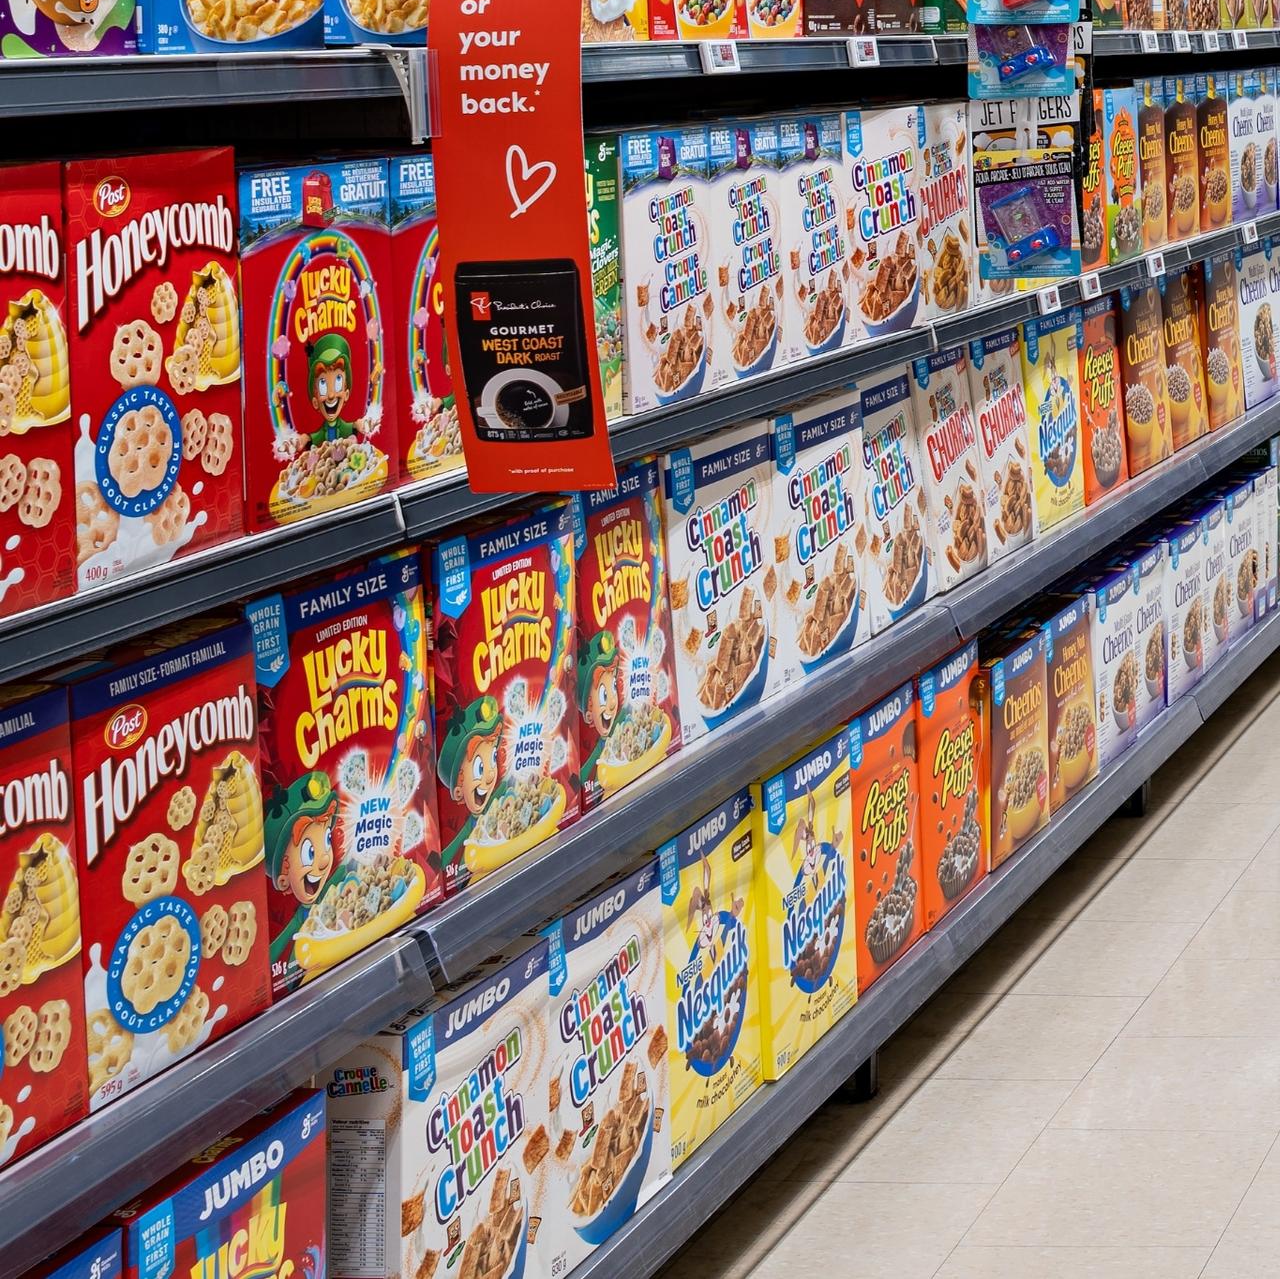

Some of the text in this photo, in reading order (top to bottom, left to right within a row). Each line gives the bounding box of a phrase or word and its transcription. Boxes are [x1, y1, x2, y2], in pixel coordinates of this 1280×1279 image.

[459, 28, 521, 55] your
[460, 61, 550, 86] money
[628, 138, 651, 155] FREE
[680, 144, 708, 160] GRATUIT
[710, 130, 731, 145] FREE
[1113, 130, 1135, 157] Reese's
[100, 181, 126, 206] Post
[251, 176, 292, 198] FREE
[252, 196, 292, 208] INSULATED
[340, 180, 386, 202] GRATUIT
[649, 185, 694, 223] Cinnamon
[76, 195, 233, 332] Honeycomb
[665, 251, 699, 286] Croque
[300, 265, 350, 310] Lucky
[660, 269, 708, 314] Cannelle
[295, 299, 356, 344] Charms
[489, 324, 555, 336] GOURMET
[481, 336, 565, 352] WEST COAST
[496, 351, 561, 365] DARK ROAST
[1091, 376, 1115, 414] Puffs
[1038, 390, 1078, 460] Nesquik
[702, 449, 751, 479] FAMILY SIZE
[686, 477, 757, 552] Cinnamon
[796, 489, 855, 566] Crunch
[480, 521, 548, 558] FAMILY SIZE
[703, 510, 750, 567] Toast
[492, 557, 533, 581] LIMITED EDITION
[696, 527, 763, 612] Crunch
[300, 574, 388, 620] FAMILY SIZE
[481, 570, 546, 641] Lucky
[253, 618, 280, 637] GRAIN
[1102, 625, 1134, 665] Cheerios
[110, 641, 226, 697] FAMILY SIZE FORMAT FAMILIAL
[302, 629, 388, 710] Lucky
[632, 657, 650, 670] NEW
[940, 651, 969, 689] JUMBO
[1053, 653, 1090, 699] Cheerios
[631, 686, 650, 699] Gems
[1003, 680, 1042, 731] Cheerios
[111, 710, 142, 745] Post
[295, 677, 400, 770] Charms
[518, 720, 544, 739] NEW
[514, 735, 545, 756] Magic
[515, 752, 542, 771] Gems
[934, 719, 975, 778] Reese's
[83, 685, 255, 867] Honeycomb
[941, 752, 974, 809] Puffs
[360, 797, 391, 817] NEW
[862, 767, 910, 834] Reese's
[354, 816, 393, 837] Magic
[356, 833, 390, 854] Gems
[686, 810, 727, 857] JUMBO
[870, 802, 909, 868] Puffs
[573, 888, 626, 942] JUMBO
[782, 854, 847, 972] Nesquik
[676, 921, 749, 1049] Nesquik
[445, 977, 511, 1039] JUMBO
[579, 976, 631, 1057] Toast
[334, 1066, 378, 1086] Croque
[776, 1050, 787, 1070] 900
[327, 1078, 389, 1097] Cannelle
[426, 1026, 523, 1154] Cinnamon
[449, 1073, 506, 1166] Toast
[199, 1140, 285, 1221] JUMBO
[141, 1215, 172, 1241] WHOLE
[145, 1245, 169, 1266] FIRST
